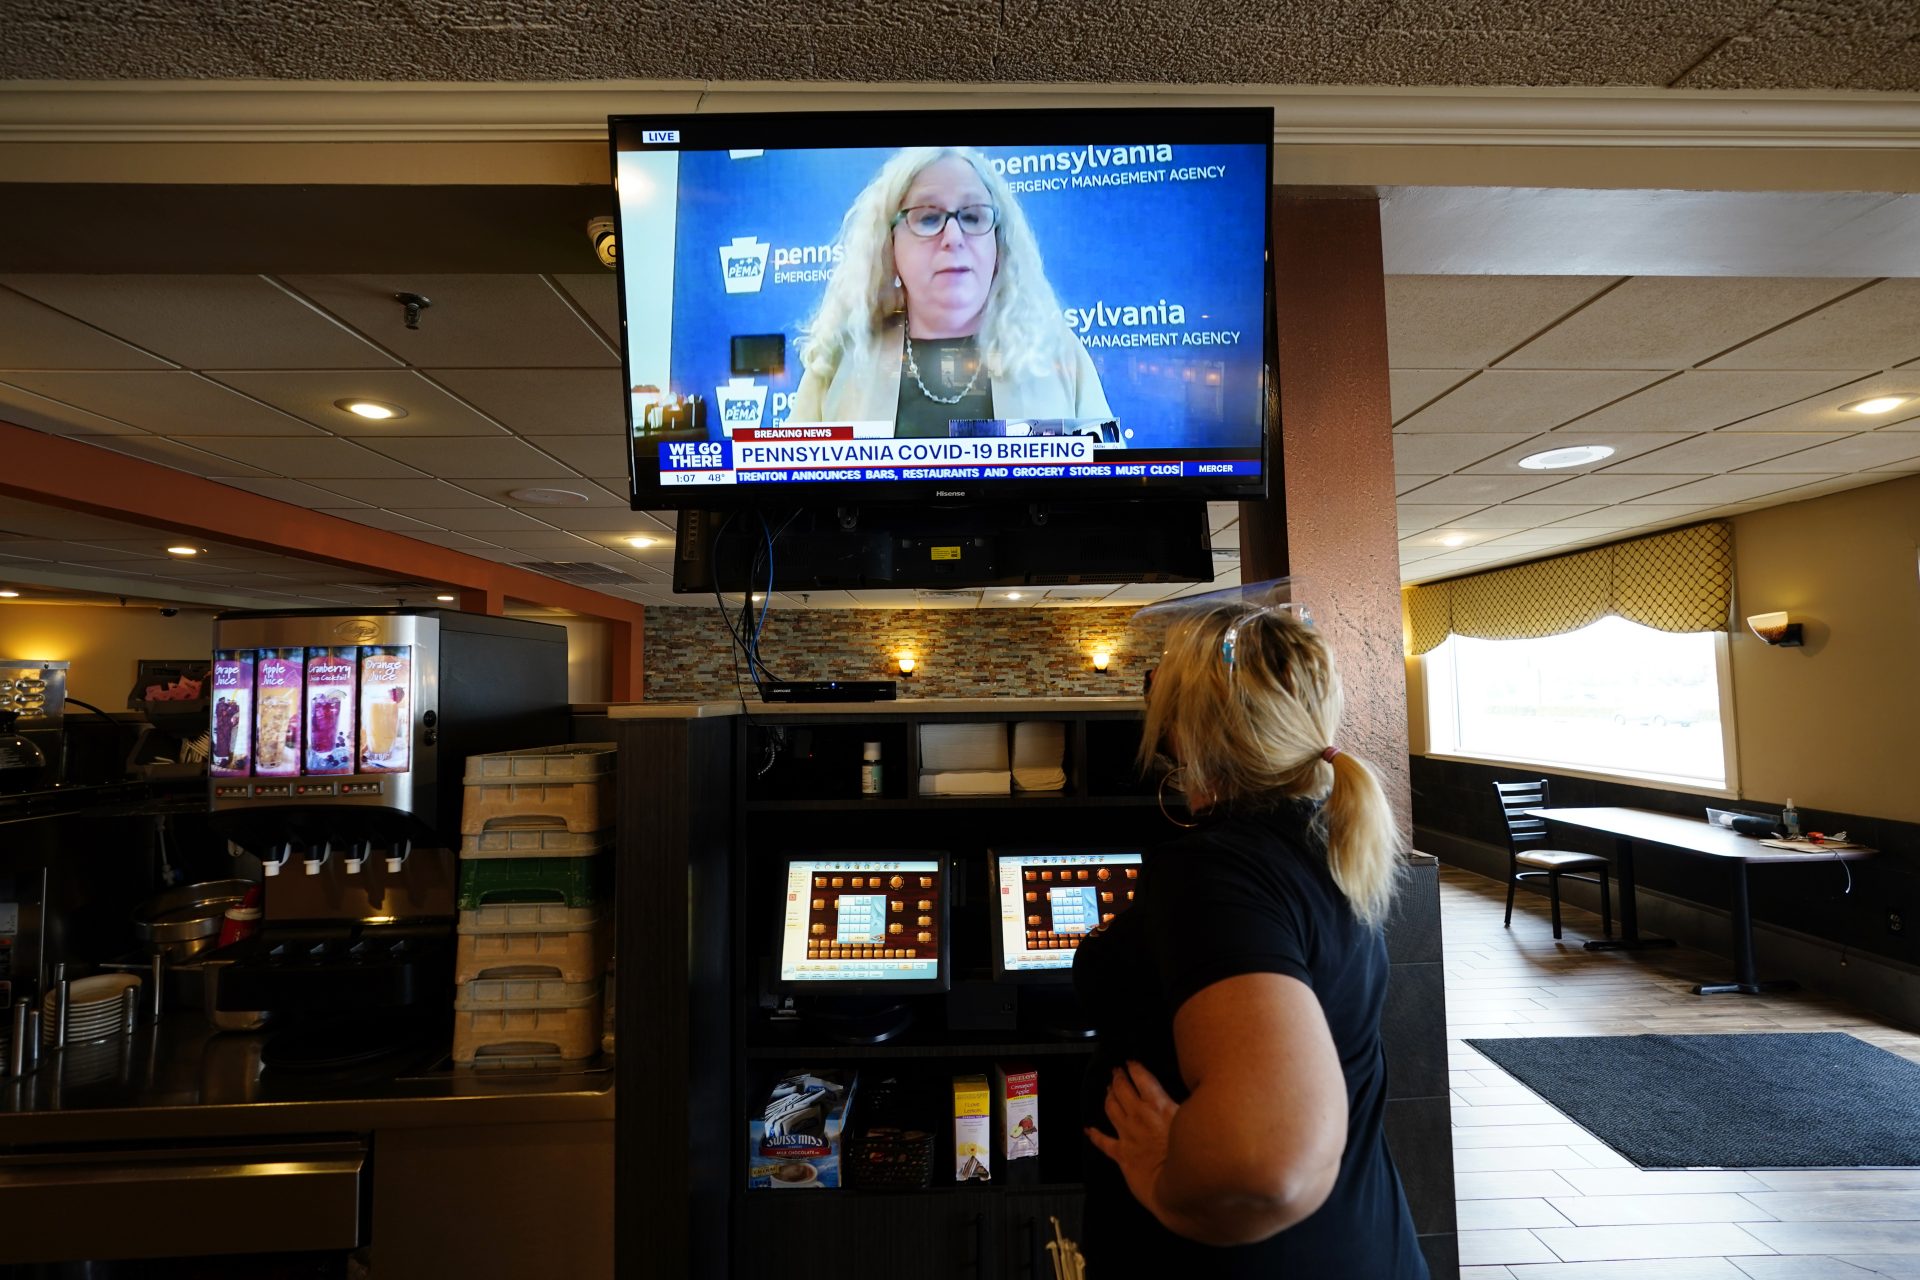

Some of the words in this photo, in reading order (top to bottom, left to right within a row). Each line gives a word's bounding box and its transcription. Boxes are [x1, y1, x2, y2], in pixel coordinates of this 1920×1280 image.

[648, 132, 675, 142] LIVE
[990, 144, 1173, 175] pennsylvania
[1009, 177, 1069, 195] ERGENCY
[1071, 169, 1166, 188] MANAGEMENT
[1169, 165, 1226, 181] AGENCY
[728, 266, 759, 278] PEMA
[774, 269, 835, 284] EMERGENC
[1064, 299, 1186, 333] sylvania
[1079, 332, 1179, 348] MANAGEMENT
[1182, 331, 1241, 346] AGENCY
[725, 408, 756, 421] PEMA
[754, 429, 802, 439] BREAKING
[803, 428, 832, 438] NEWS
[669, 443, 695, 455] WE
[698, 442, 722, 455] GO
[742, 445, 894, 463] PENNSYLVANIA
[898, 443, 993, 461] COVID-19
[997, 442, 1085, 459] BRIEFING
[669, 455, 723, 468] THERE
[737, 471, 788, 482] TRENTON
[791, 470, 861, 481] ANNOUNCES
[865, 469, 899, 481] BARS,
[902, 468, 980, 479] RESTAURANTS
[983, 467, 1009, 478] AND
[1012, 466, 1065, 477] GROCERY
[1069, 465, 1112, 476] STORES
[1115, 465, 1147, 475] MUST
[1198, 464, 1234, 473] MERCER
[675, 474, 696, 483] 1:07
[215, 664, 240, 678] Grape
[262, 664, 286, 679] Apple
[307, 663, 352, 679] Cranberry
[365, 660, 402, 675] Orange
[215, 676, 237, 686] Juice
[261, 675, 285, 686] Juice
[367, 673, 398, 682] Juice
[766, 1135, 797, 1147] SWISS
[798, 1134, 823, 1147] MISS
